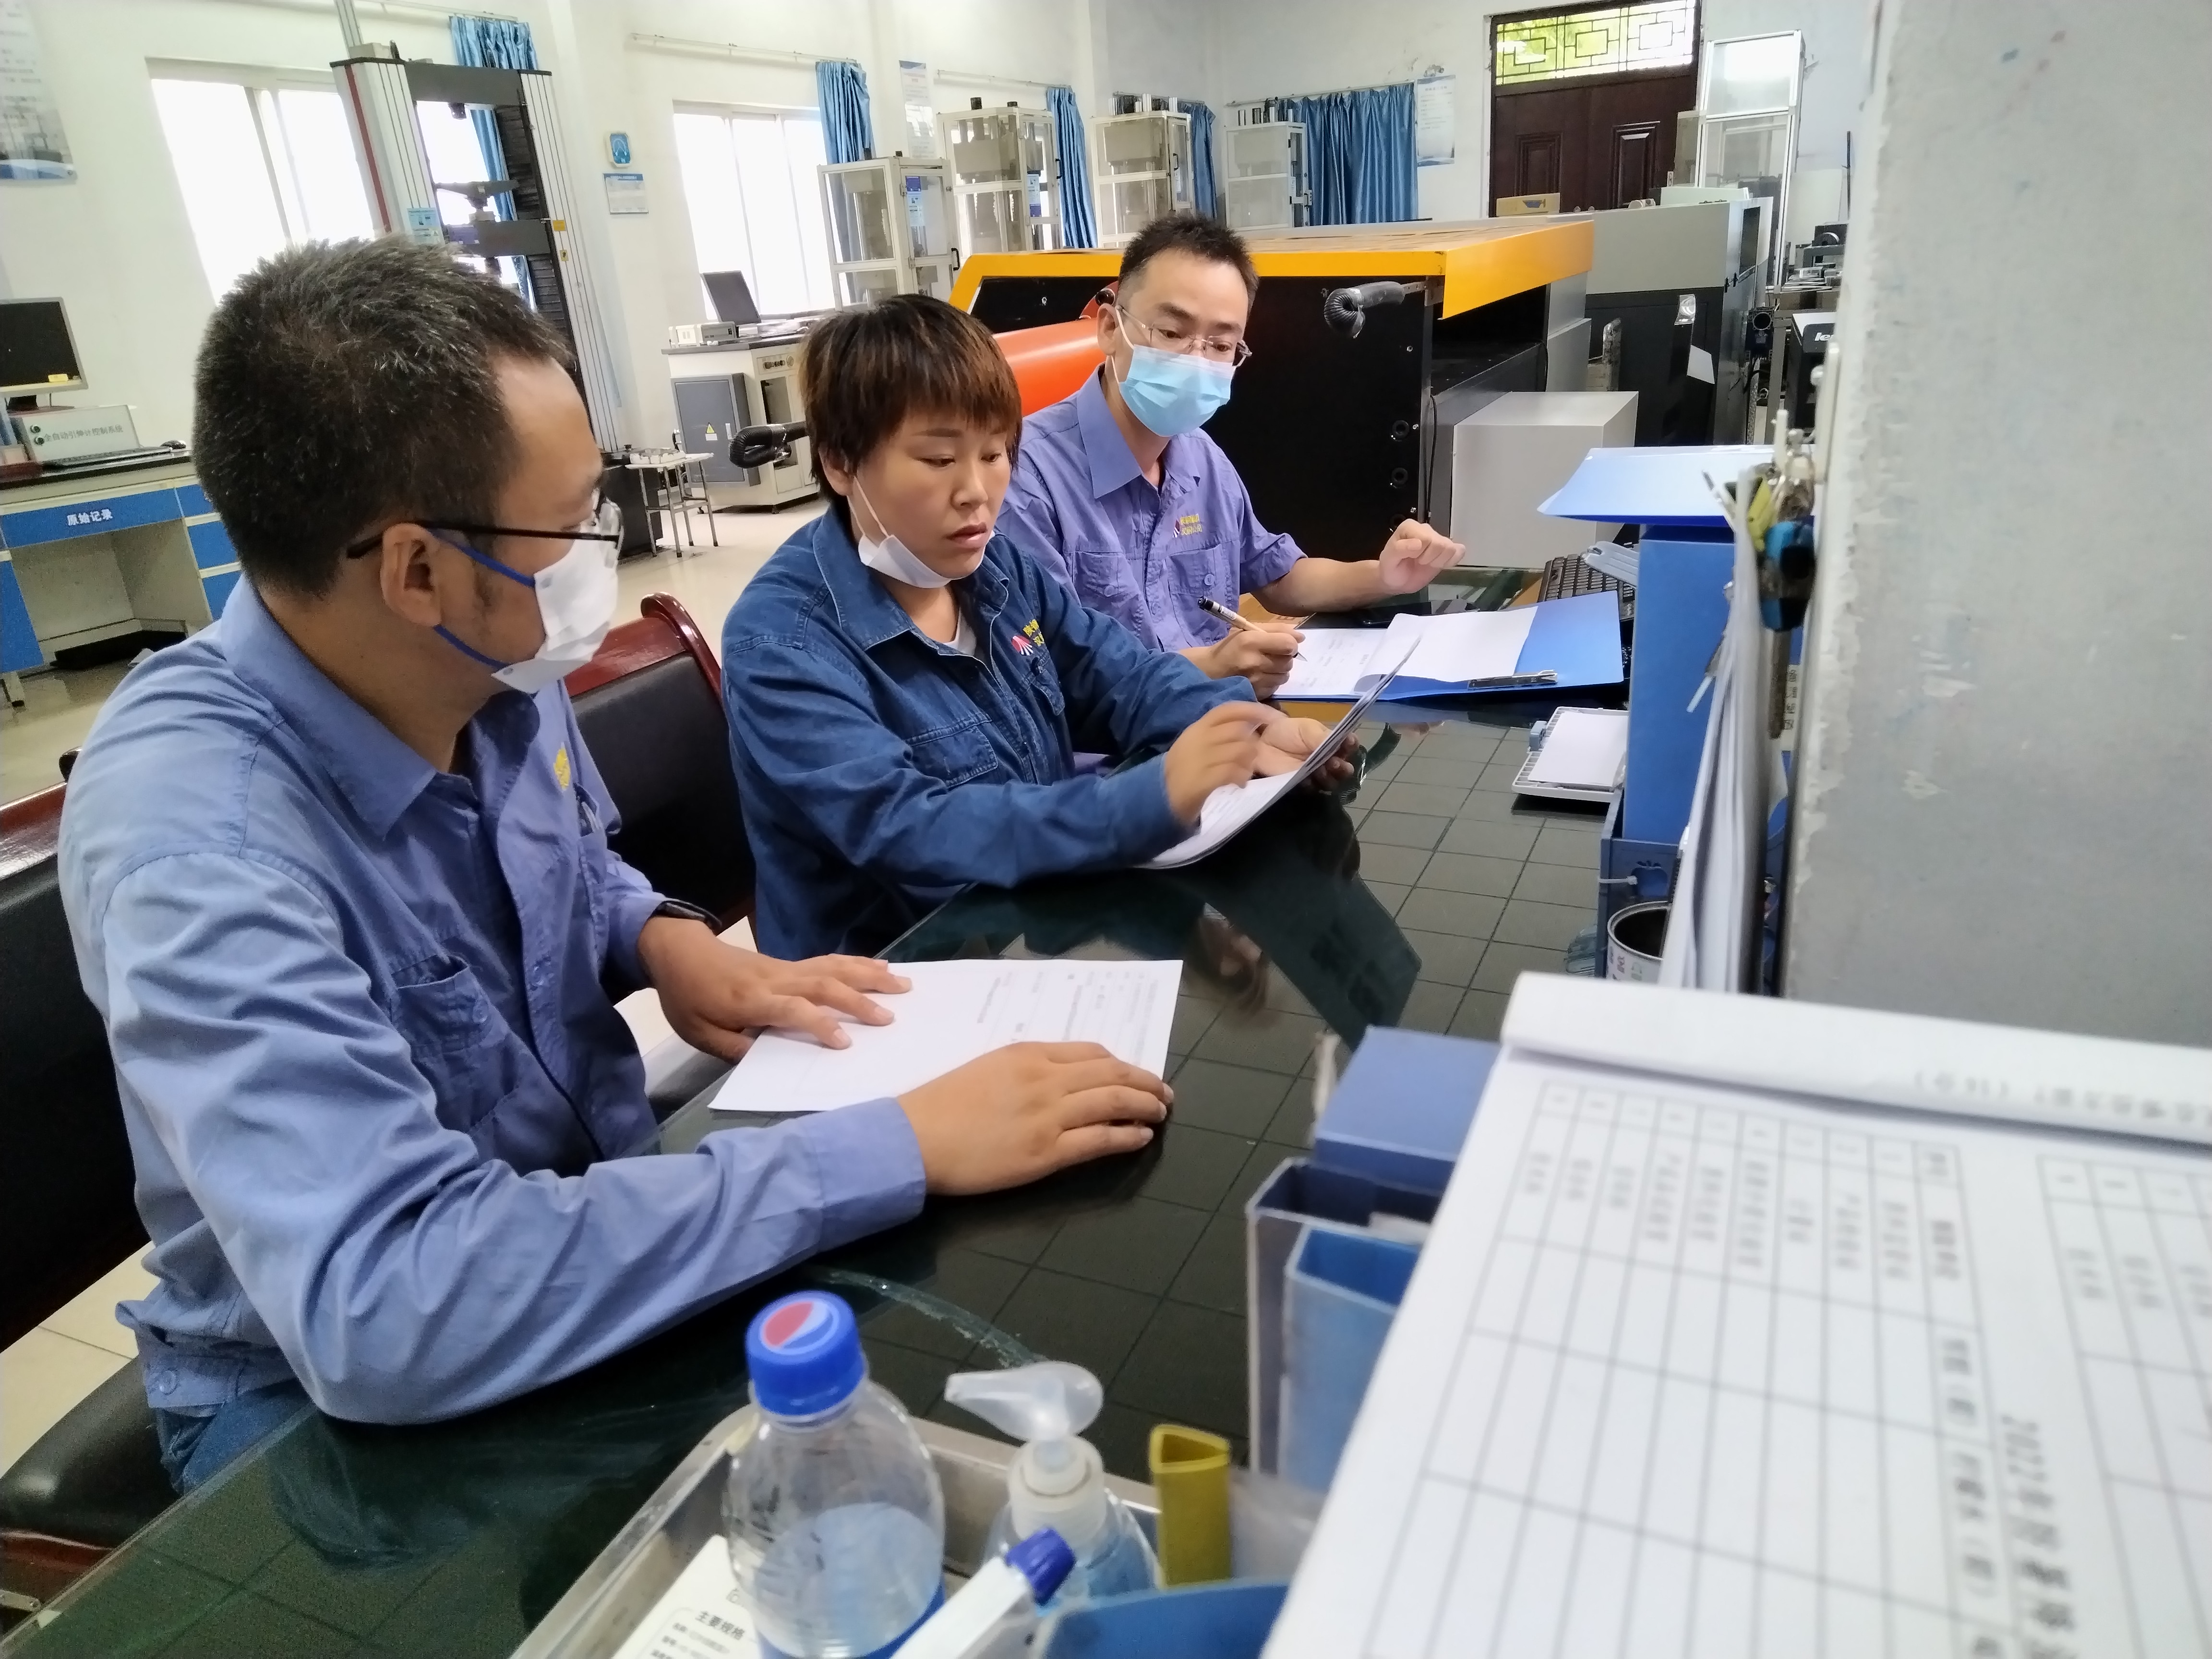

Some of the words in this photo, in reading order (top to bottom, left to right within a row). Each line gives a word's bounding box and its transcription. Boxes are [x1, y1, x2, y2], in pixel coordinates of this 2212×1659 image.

[67, 508, 113, 526] 原始记录
[695, 1610, 746, 1641] 主要规格
